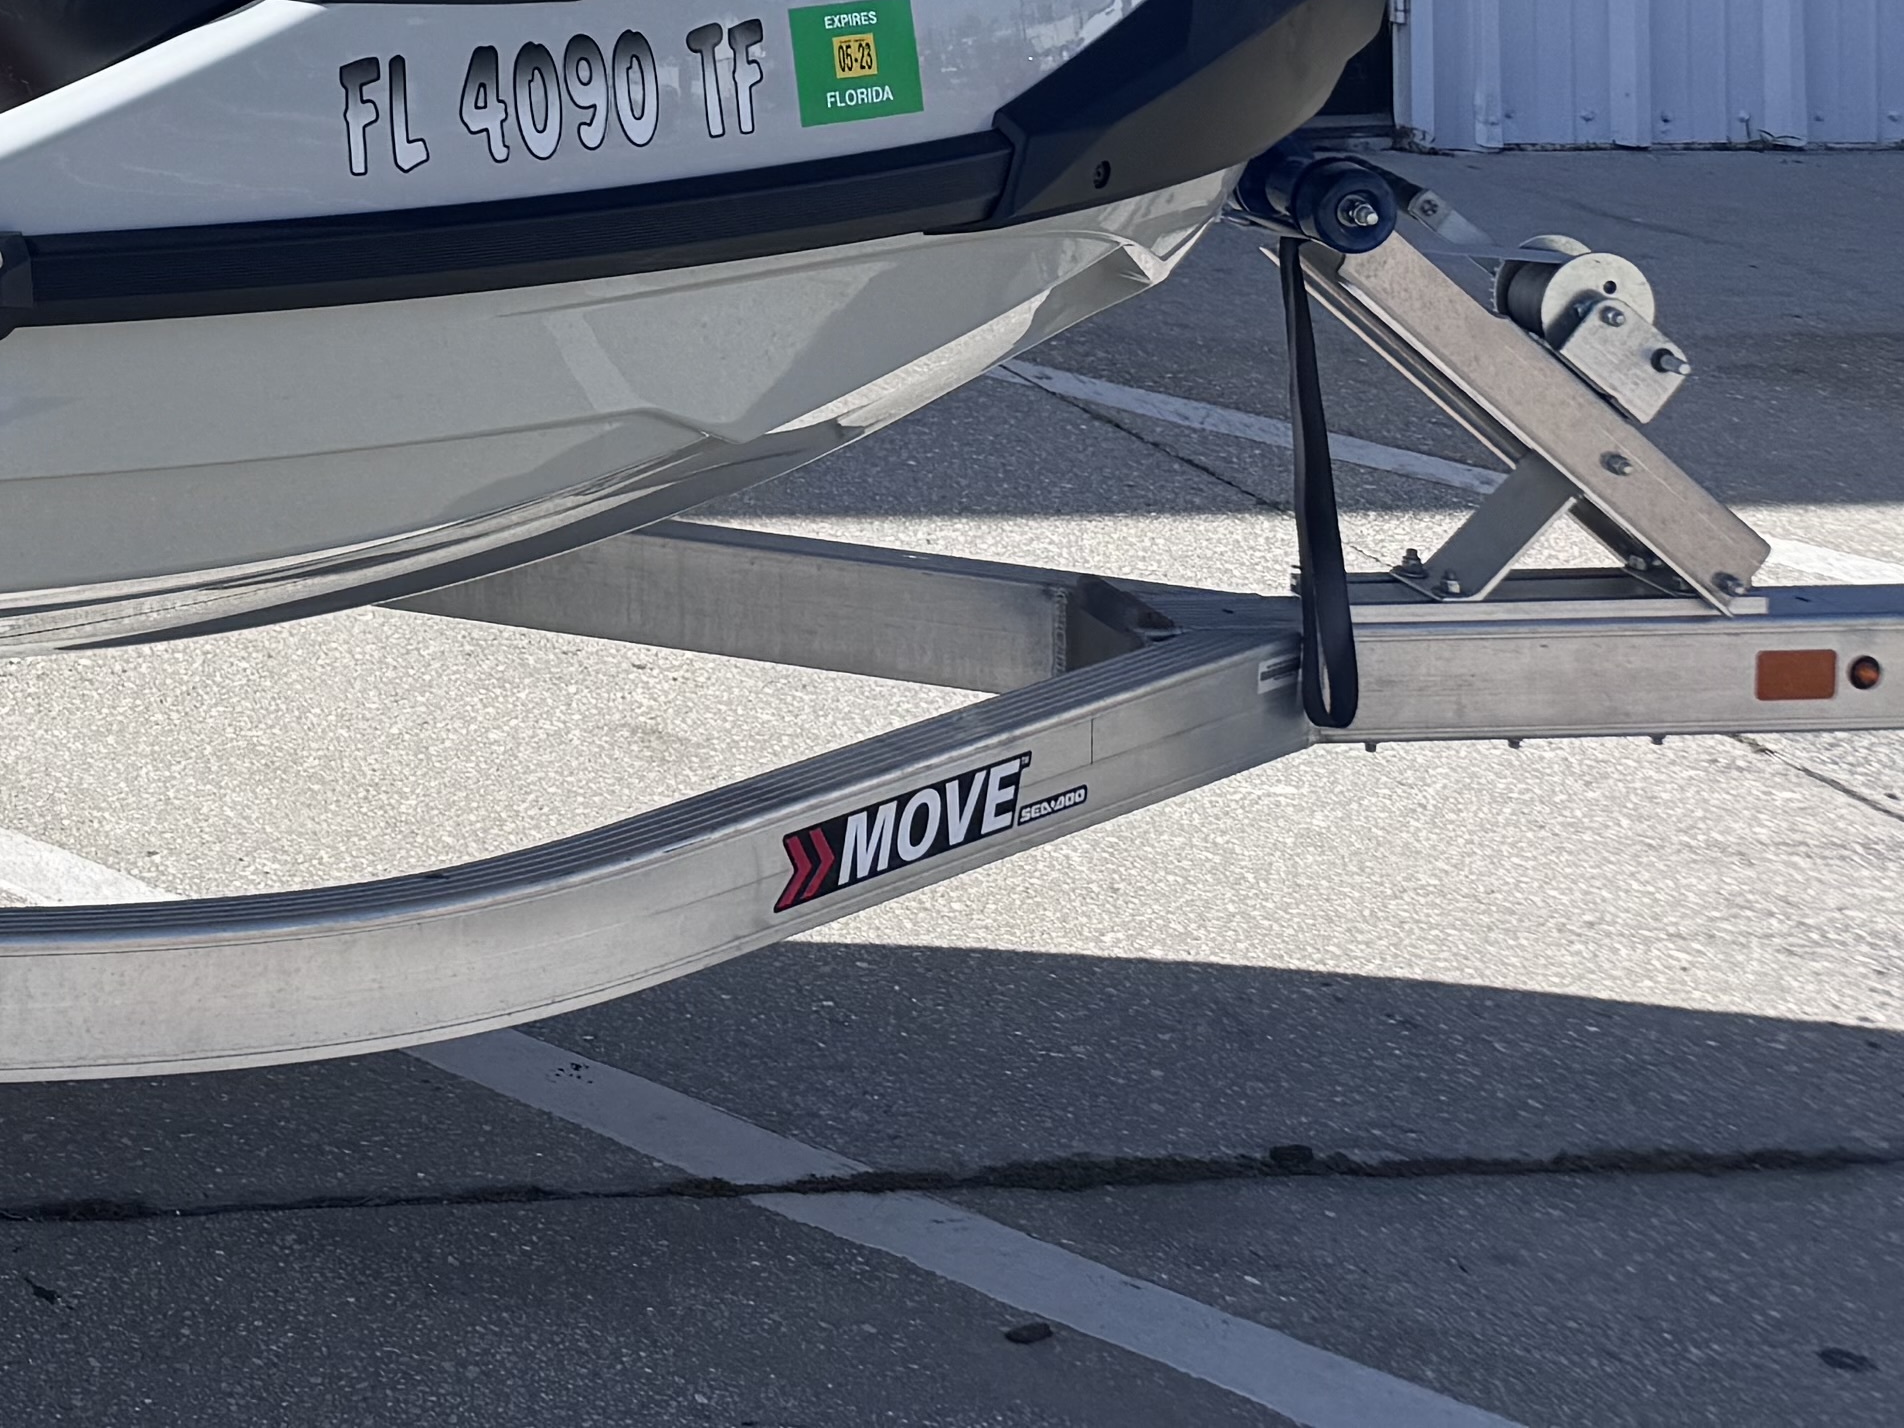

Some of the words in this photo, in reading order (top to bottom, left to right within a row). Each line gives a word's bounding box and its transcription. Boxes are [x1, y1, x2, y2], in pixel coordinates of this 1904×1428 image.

[824, 11, 877, 29] EXPIRES
[339, 55, 429, 176] FL
[459, 30, 659, 162] 4090
[686, 18, 763, 138] TF
[827, 85, 893, 108] FLORIDA
[838, 758, 1021, 885] MOVE
